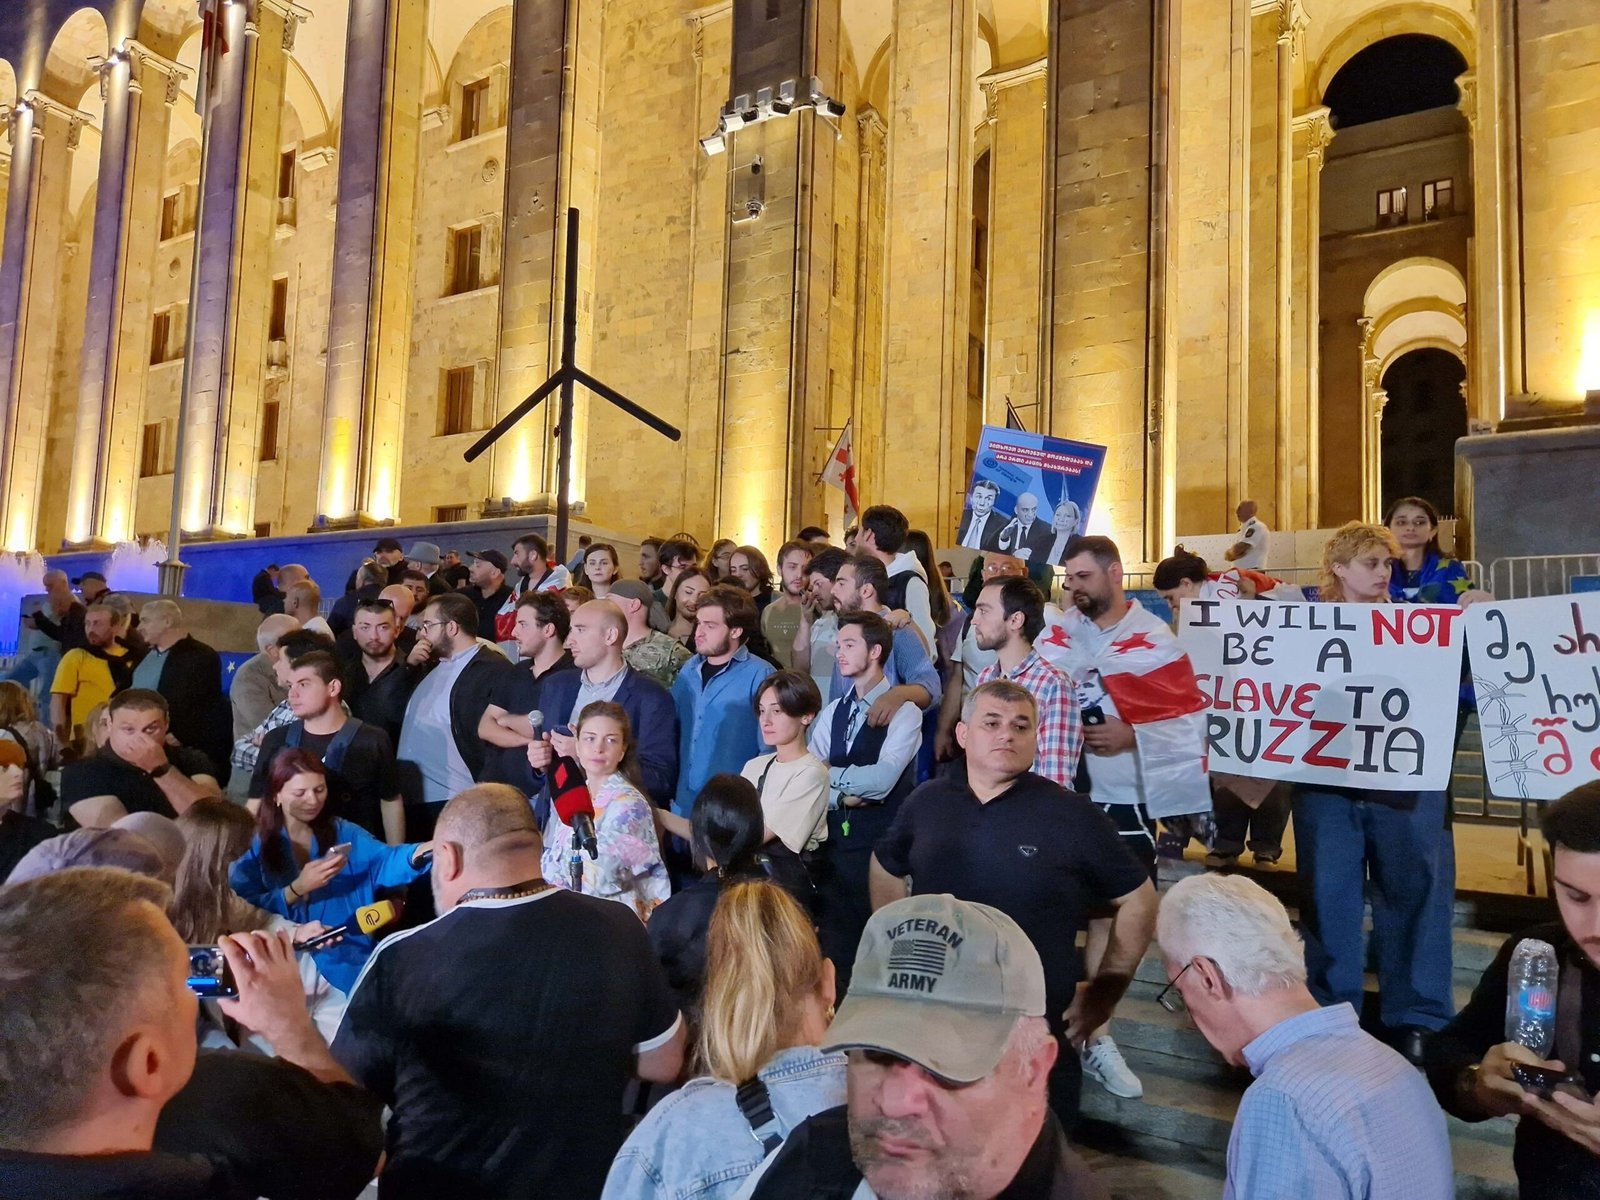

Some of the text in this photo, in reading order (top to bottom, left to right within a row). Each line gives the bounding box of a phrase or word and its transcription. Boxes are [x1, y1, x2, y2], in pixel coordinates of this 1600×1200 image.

[1189, 601, 1464, 647] I WILL NOT
[1485, 608, 1536, 684] მე
[1223, 632, 1352, 673] BE A
[1195, 674, 1410, 722] SLAVE TO
[1541, 666, 1600, 733] რუ
[1206, 713, 1425, 776] RUZZIA
[886, 918, 963, 949] VETERAN
[888, 973, 938, 993] ARMY
